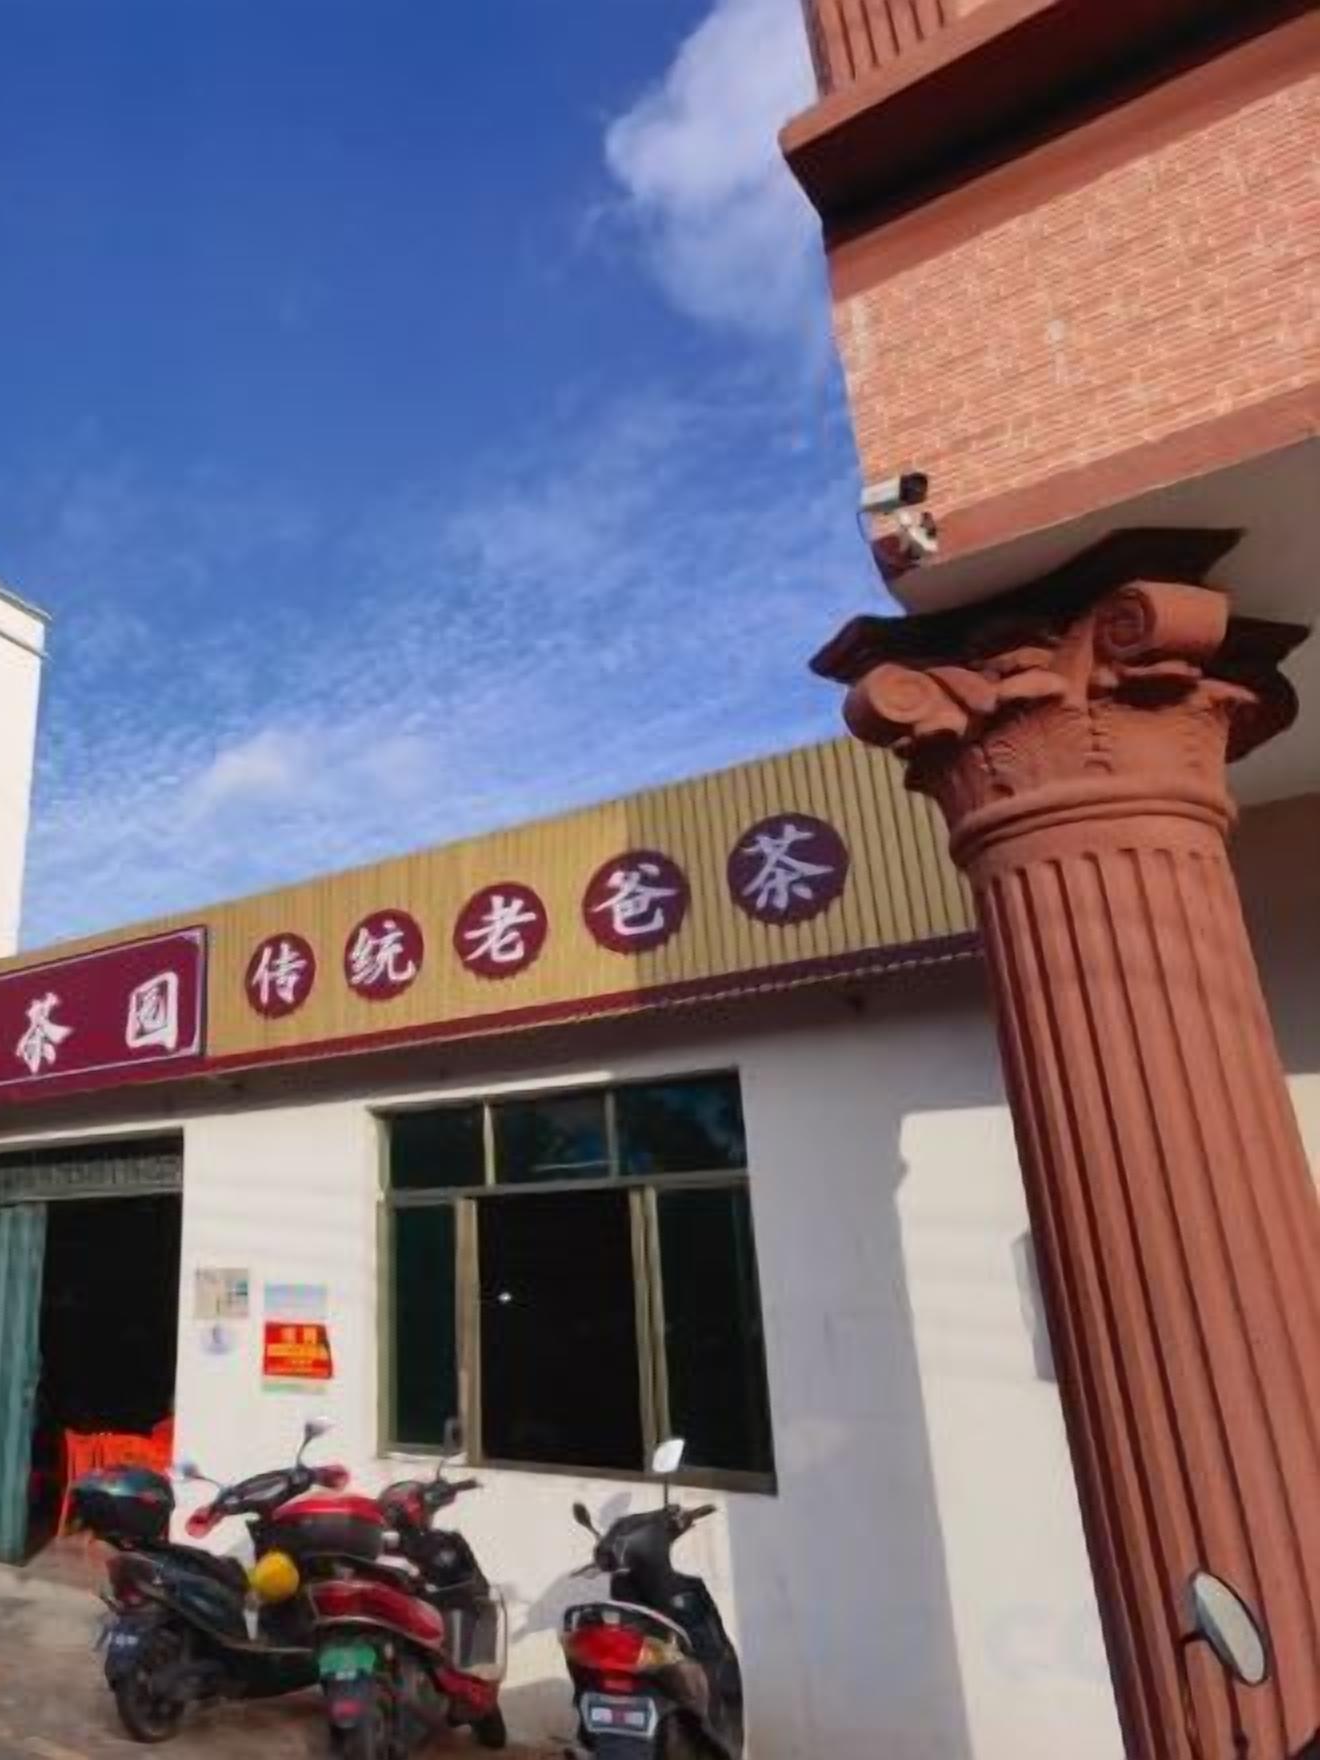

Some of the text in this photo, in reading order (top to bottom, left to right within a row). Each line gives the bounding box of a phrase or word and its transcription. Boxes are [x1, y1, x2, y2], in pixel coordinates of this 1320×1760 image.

[251, 822, 837, 1005] 传统老爸茶
